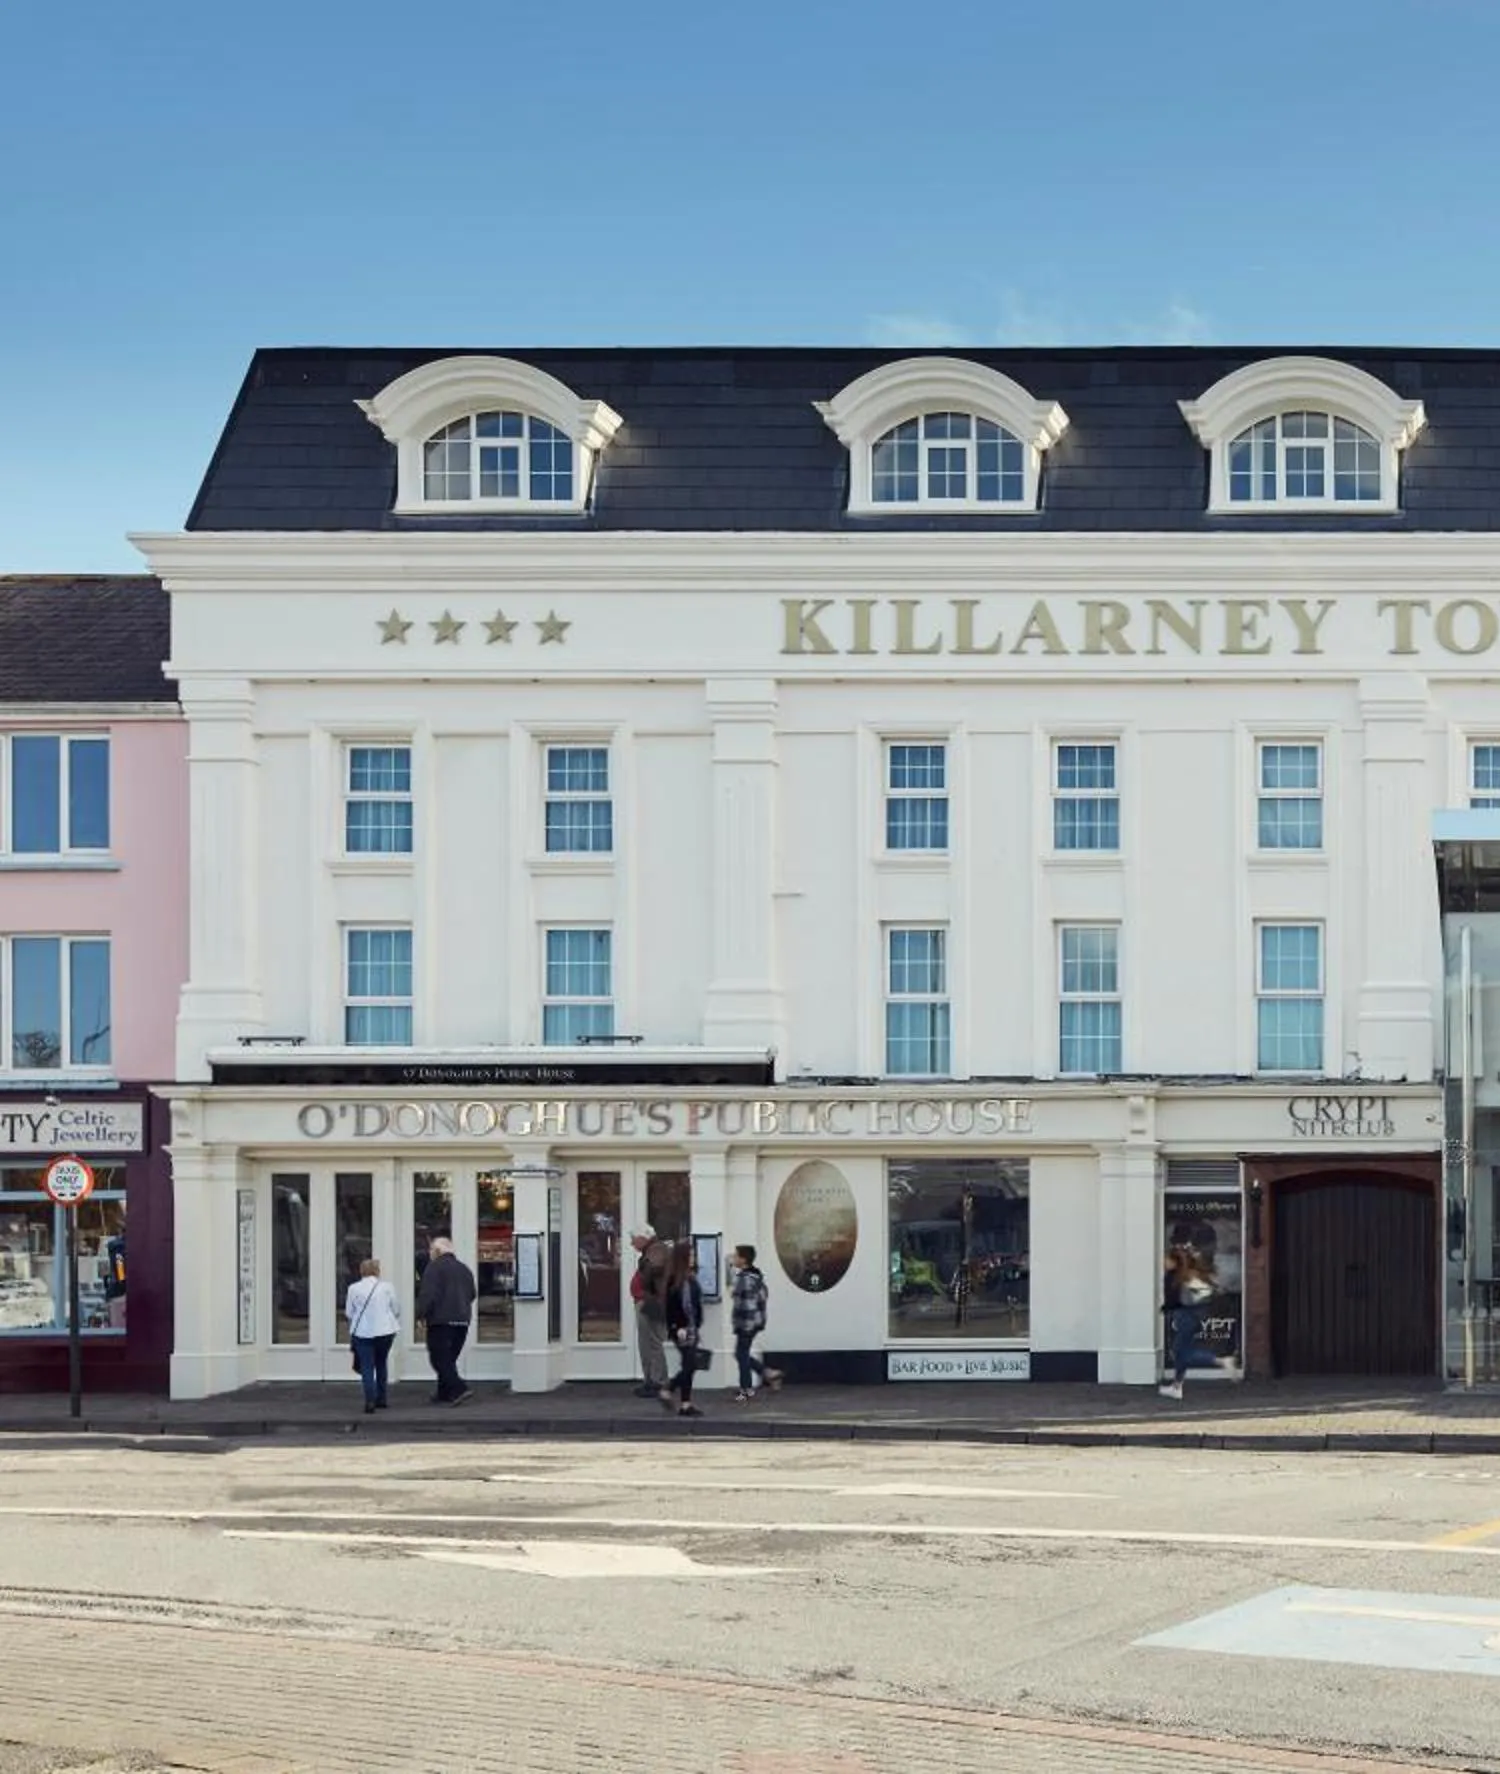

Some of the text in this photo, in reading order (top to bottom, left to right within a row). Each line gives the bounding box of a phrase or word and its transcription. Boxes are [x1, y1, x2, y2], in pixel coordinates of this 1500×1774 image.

[777, 598, 1337, 656] KILLARNEY
[57, 1109, 116, 1126] Celtic
[299, 1099, 1033, 1138] O'DONOGHUE'S PUBLIC HOUSE
[1288, 1095, 1397, 1121] CRYPT
[48, 1127, 138, 1146] Jewellery
